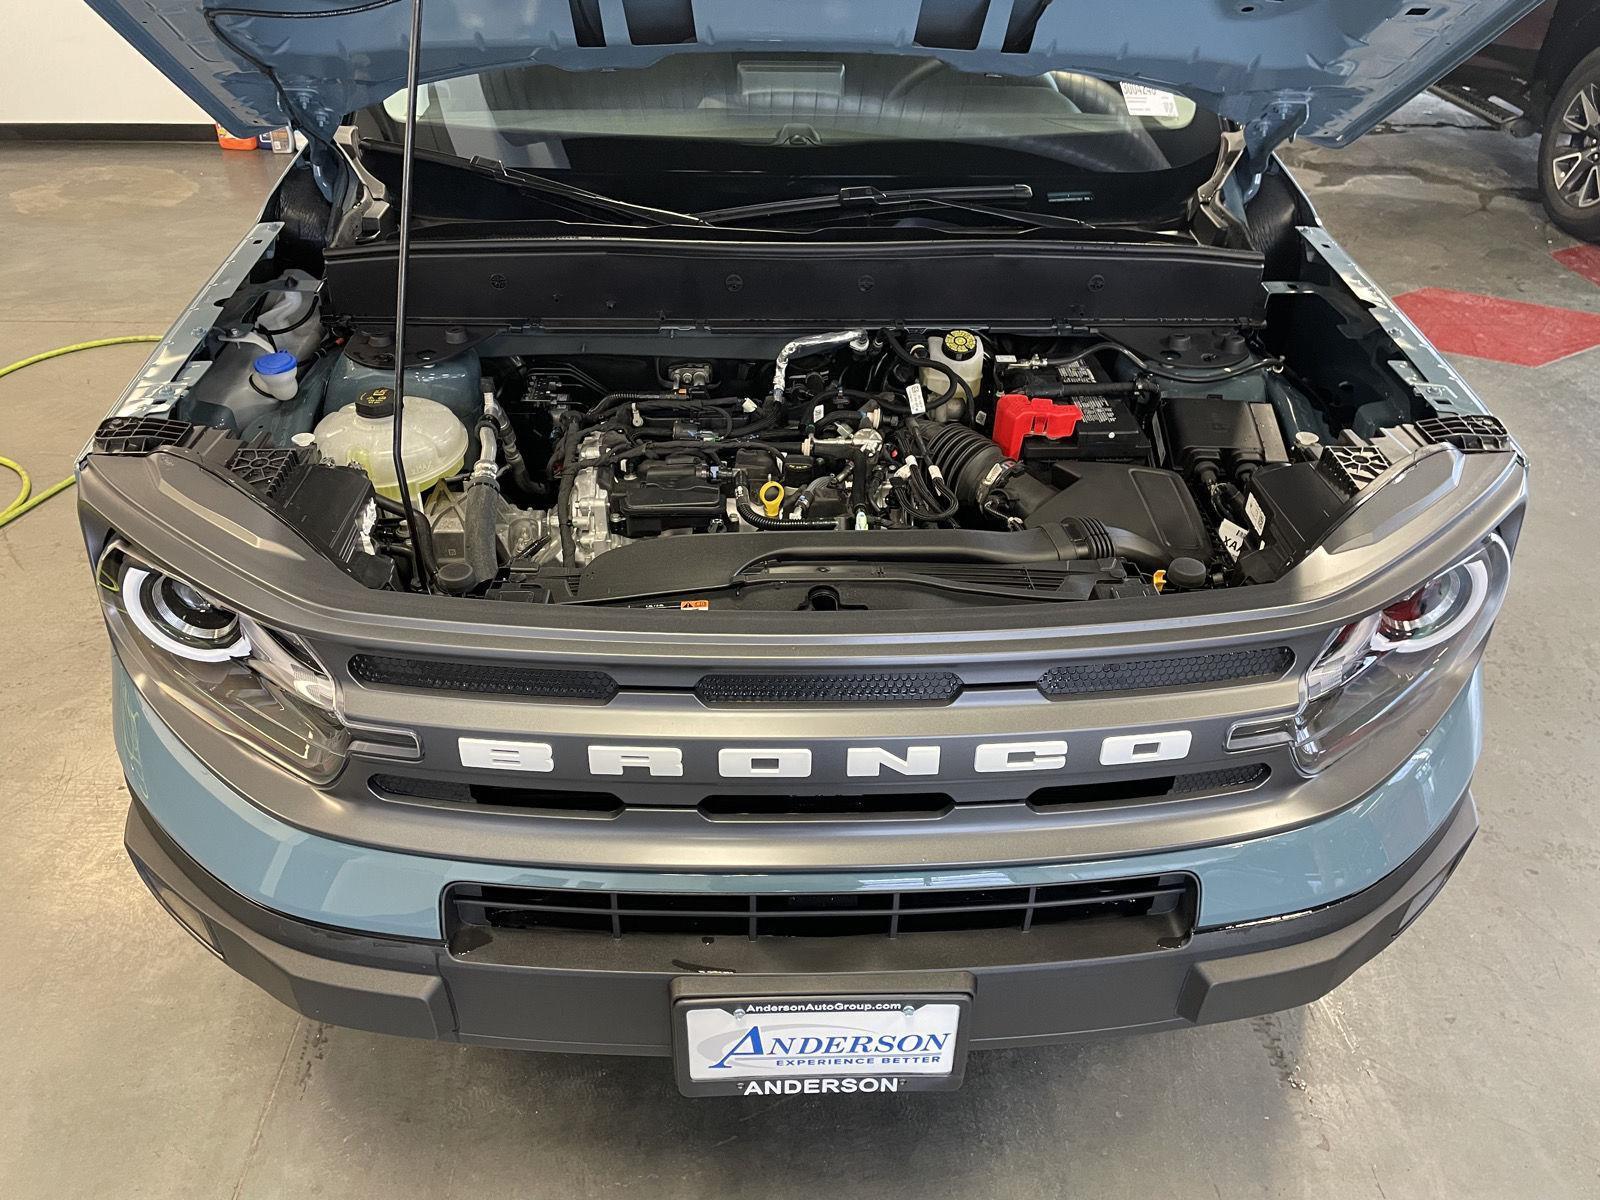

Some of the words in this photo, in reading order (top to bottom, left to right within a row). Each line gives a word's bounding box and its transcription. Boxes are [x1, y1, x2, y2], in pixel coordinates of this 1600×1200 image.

[458, 730, 1192, 778] BRONCO
[746, 1002, 902, 1013] AndersonAutoGroup.com
[708, 1025, 952, 1069] ANDERSON
[776, 1057, 875, 1067] EXPERIENCE
[881, 1055, 941, 1065] BETTER
[744, 1077, 899, 1096] ANDERSON
